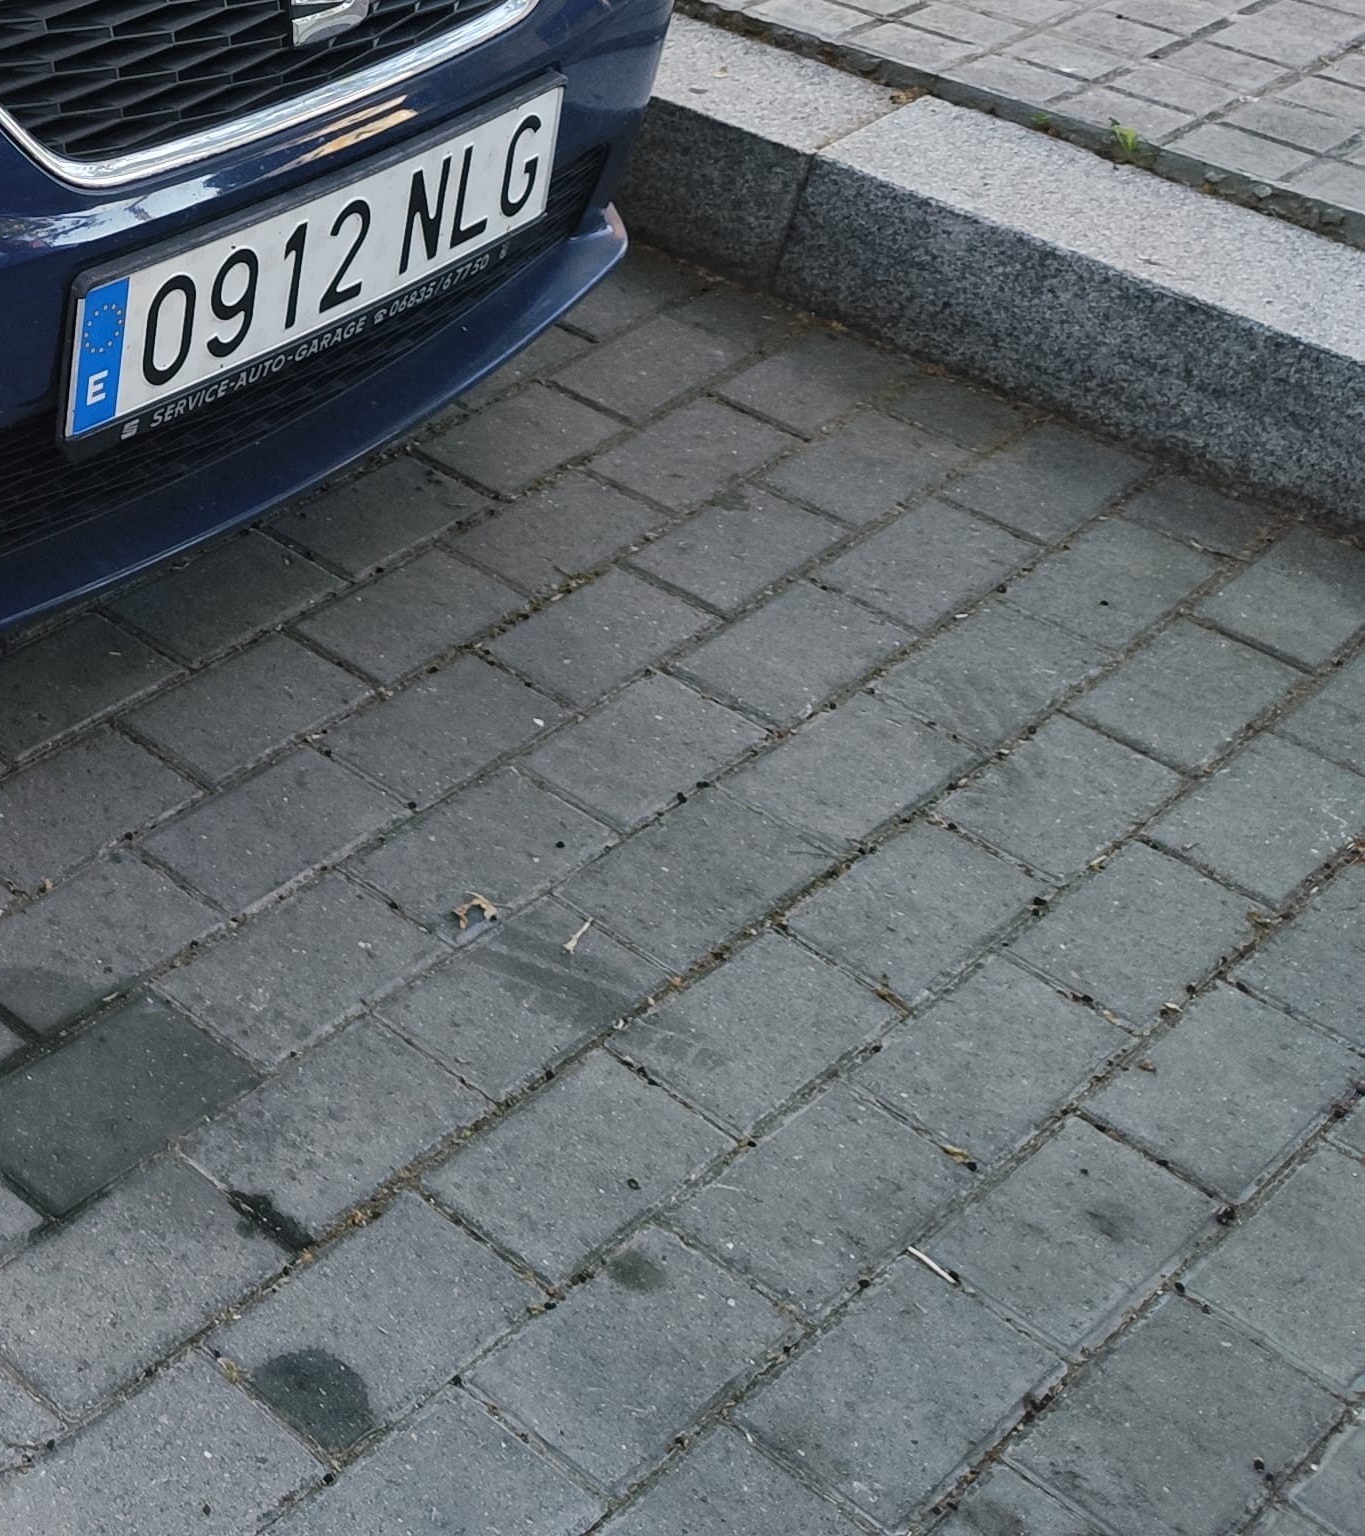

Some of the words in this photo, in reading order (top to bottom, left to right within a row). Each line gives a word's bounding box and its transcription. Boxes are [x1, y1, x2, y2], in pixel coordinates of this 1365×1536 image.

[85, 370, 107, 407] E
[143, 199, 371, 386] 0912
[399, 114, 542, 275] NLG
[150, 314, 368, 428] SERVICE-AUTO-GARAGE
